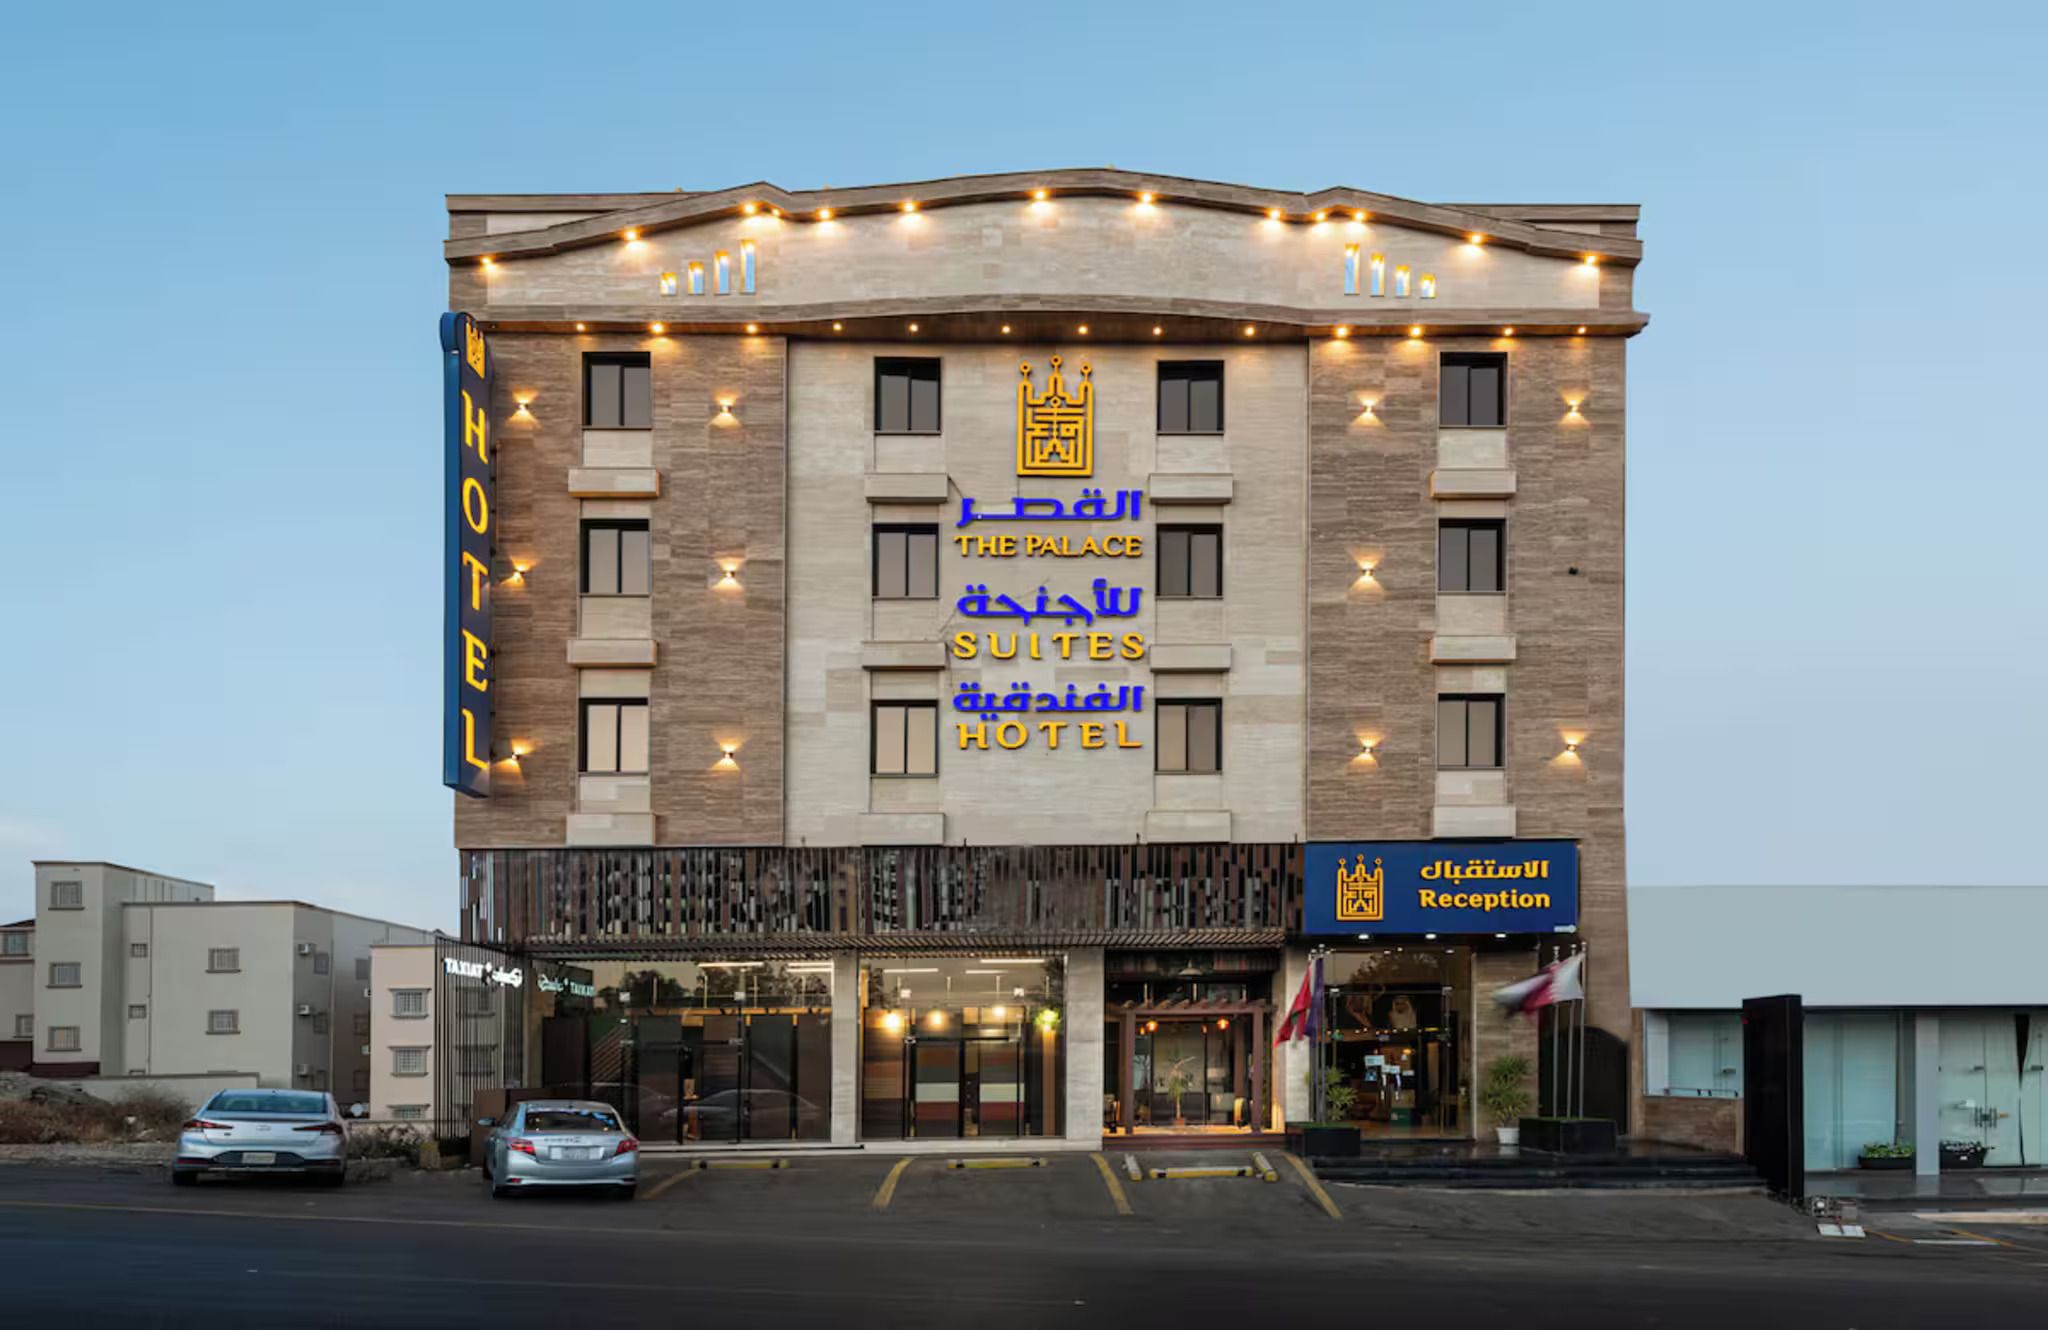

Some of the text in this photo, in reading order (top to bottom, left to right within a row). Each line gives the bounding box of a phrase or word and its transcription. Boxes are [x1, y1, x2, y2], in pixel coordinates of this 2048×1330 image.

[956, 487, 1143, 528] القصر
[954, 535, 1144, 557] THE PALACE
[462, 389, 489, 769] HOTEL
[956, 577, 1143, 627] للأجنحة
[953, 631, 1146, 660] SUITES
[952, 681, 1145, 721] الفندقية
[956, 720, 1143, 750] HOTEL
[1420, 859, 1550, 885] الاستقبال
[1418, 889, 1551, 912] Reception
